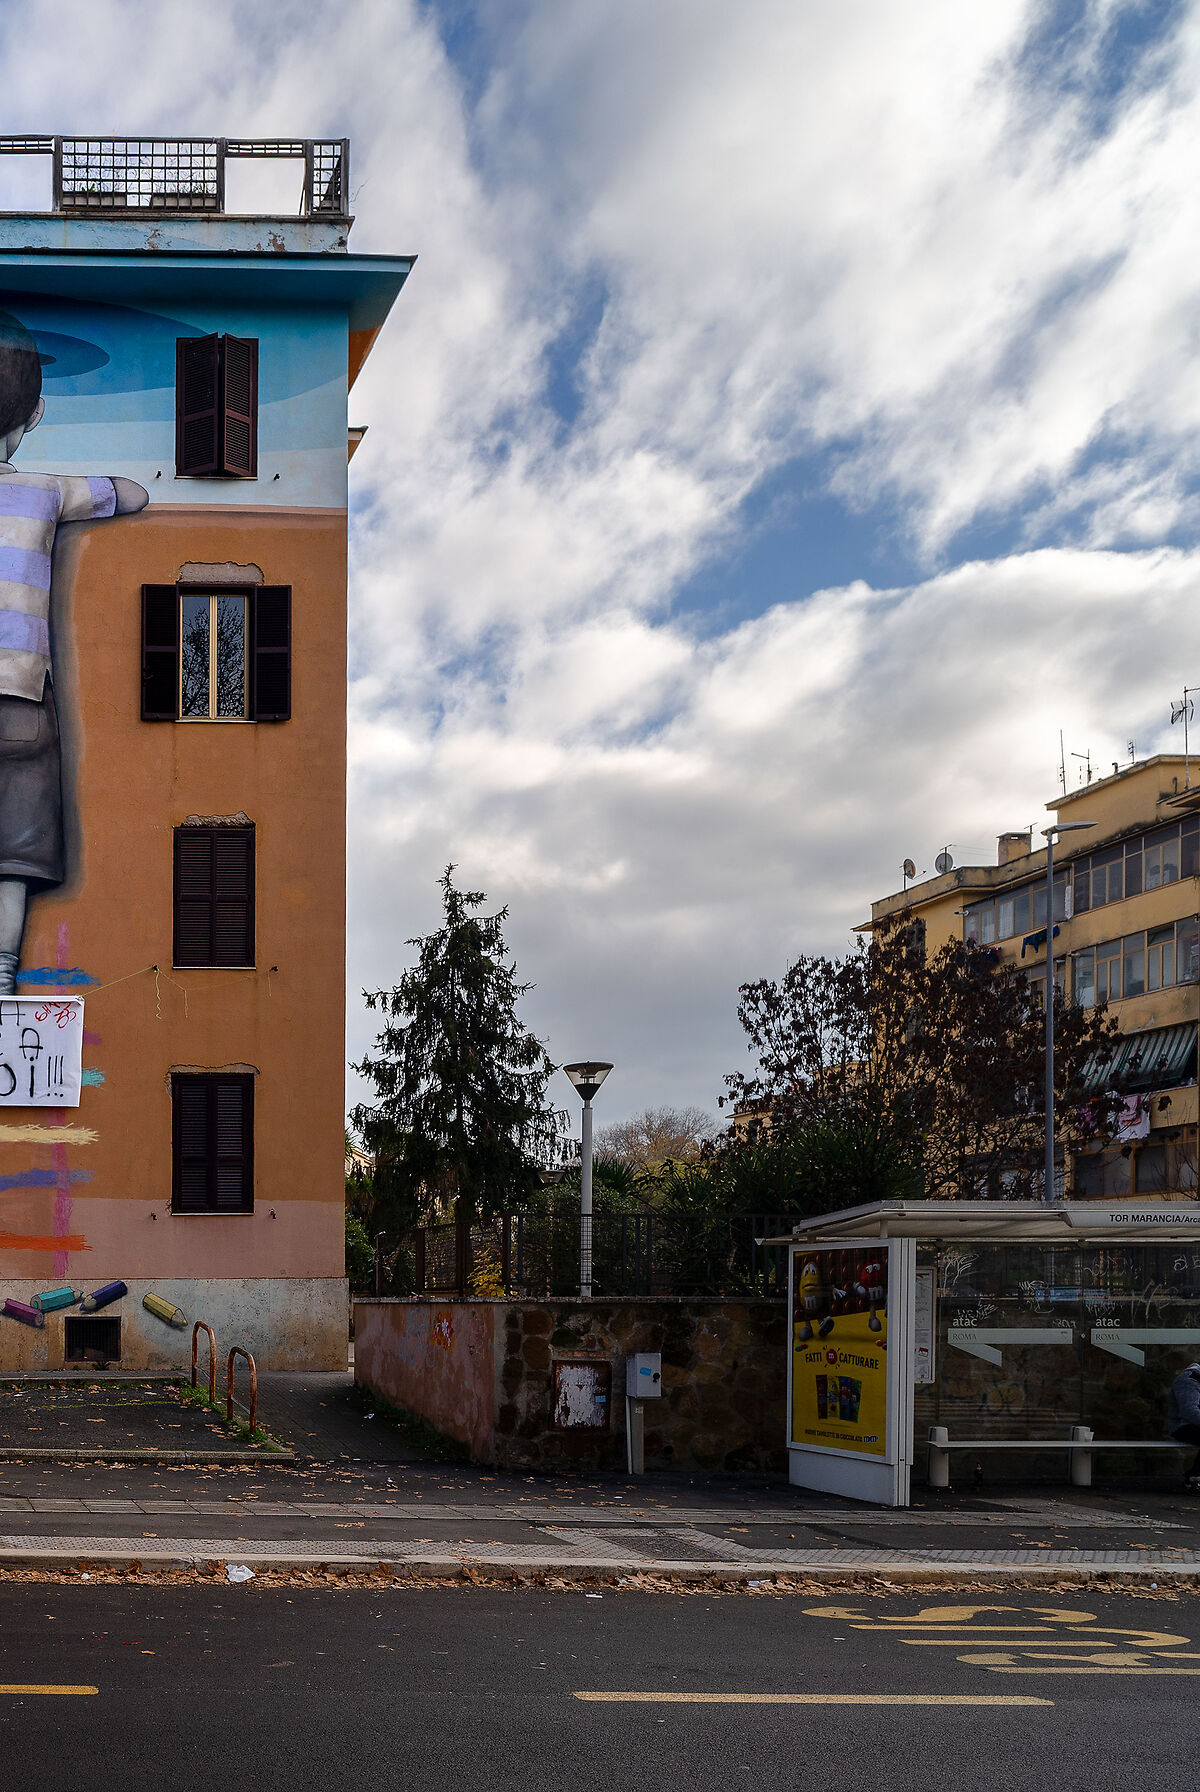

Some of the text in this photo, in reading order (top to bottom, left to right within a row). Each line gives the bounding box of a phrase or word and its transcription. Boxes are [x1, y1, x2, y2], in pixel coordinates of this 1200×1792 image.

[1109, 1214, 1129, 1223] TOR
[952, 1317, 978, 1327] atac
[1095, 1317, 1121, 1327] atac
[952, 1333, 977, 1341] ROMA
[1095, 1333, 1121, 1341] ROMA
[804, 1351, 822, 1363] FATTI
[838, 1352, 879, 1370] CATTURARE
